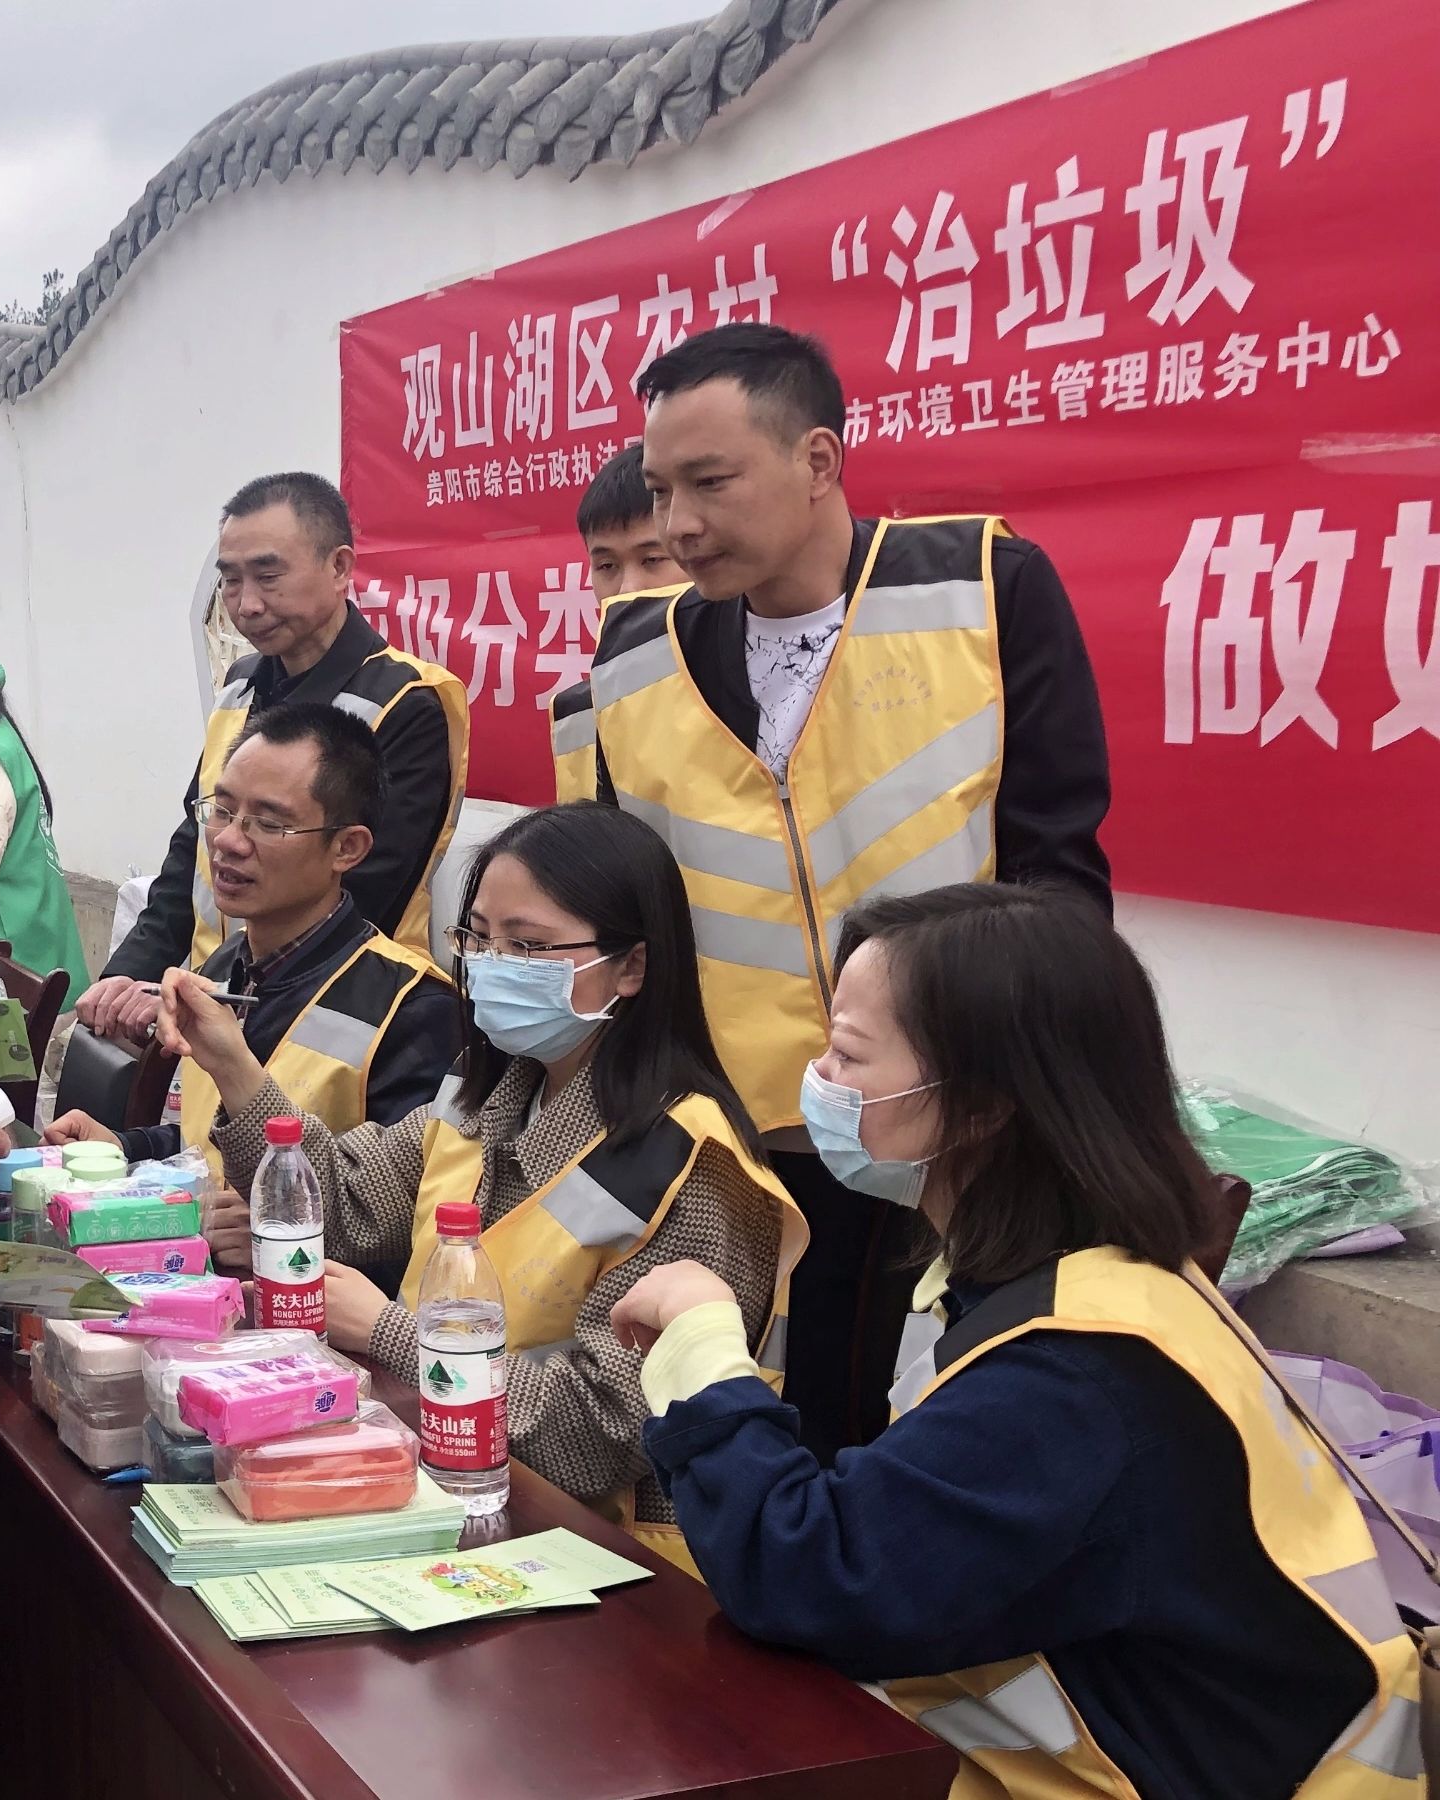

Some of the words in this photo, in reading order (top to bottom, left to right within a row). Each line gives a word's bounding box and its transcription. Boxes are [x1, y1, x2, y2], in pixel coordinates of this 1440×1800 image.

[843, 312, 1402, 449] 市环境卫生管理服务中心
[271, 1287, 324, 1309] 农夫山泉
[272, 1310, 302, 1319] NONGFU
[443, 1436, 477, 1447] SPRING
